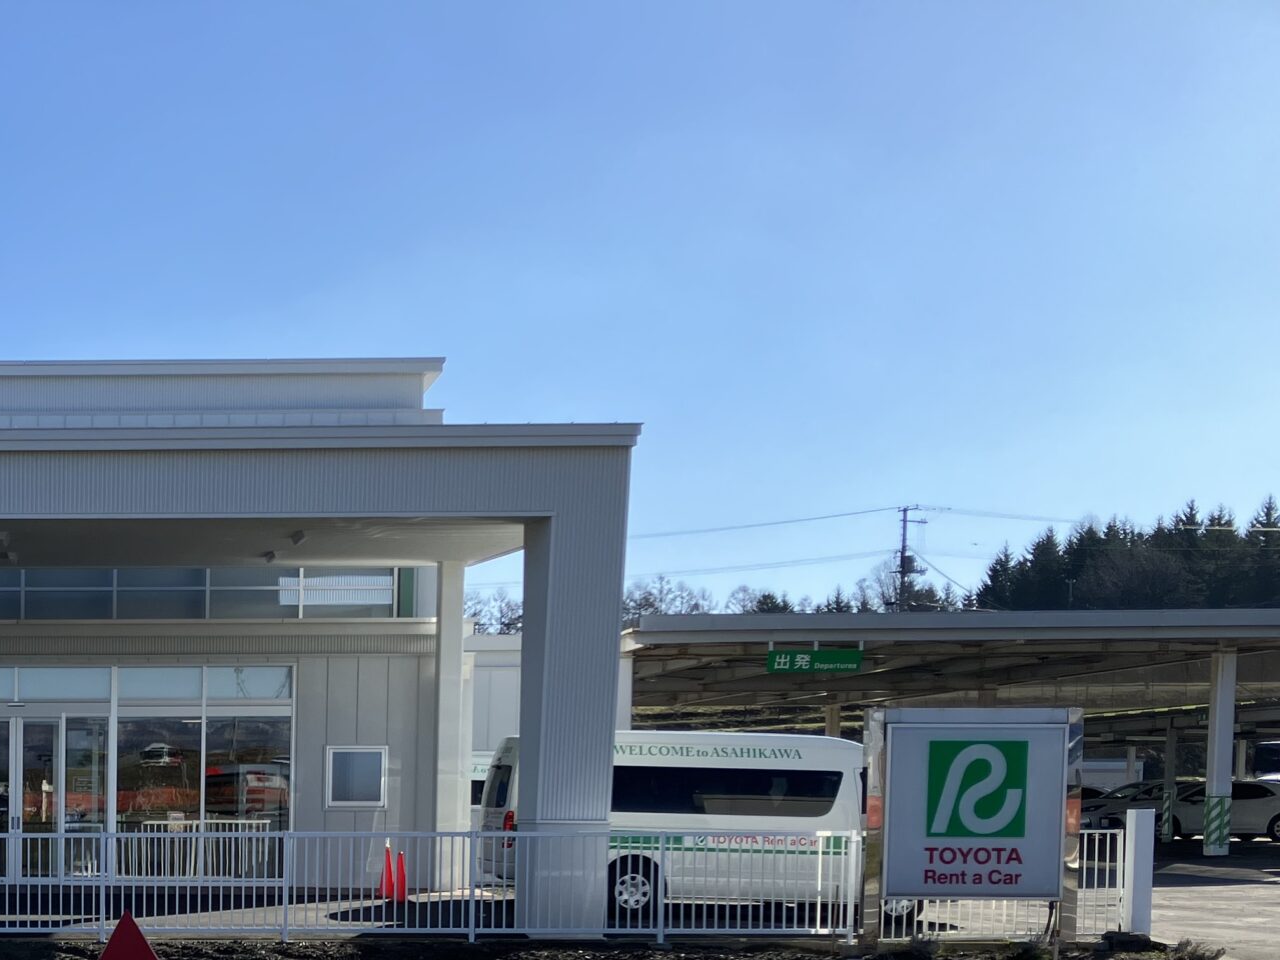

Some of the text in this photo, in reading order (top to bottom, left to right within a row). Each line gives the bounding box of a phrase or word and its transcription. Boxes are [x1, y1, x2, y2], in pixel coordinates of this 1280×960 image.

[774, 654, 811, 670] 出発
[613, 744, 803, 760] WELCOME to ASAHIKAWA
[709, 835, 759, 845] TOYOTA
[924, 847, 1023, 865] TOYOTA
[923, 869, 1022, 885] Rent a Car
